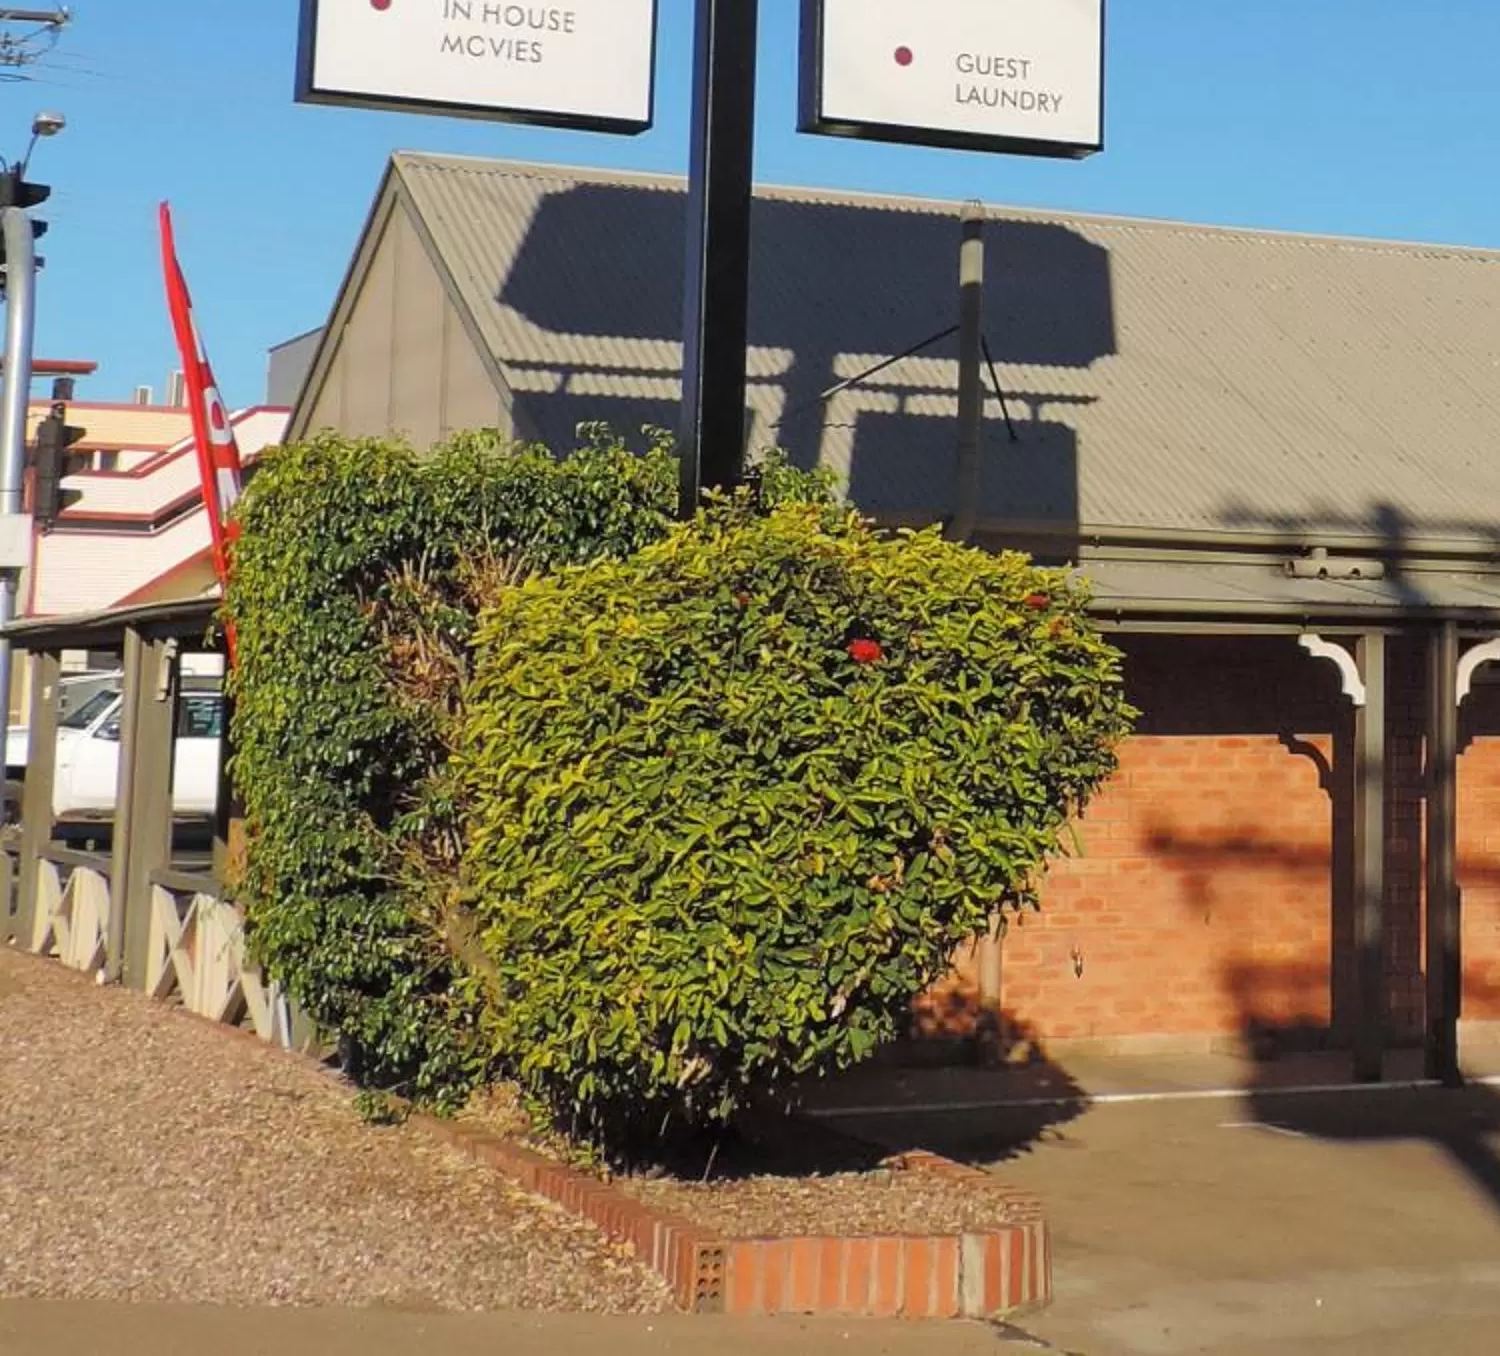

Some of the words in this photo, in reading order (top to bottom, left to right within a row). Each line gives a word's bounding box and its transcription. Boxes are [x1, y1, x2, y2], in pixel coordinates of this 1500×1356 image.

[482, 3, 576, 33] HOUSE
[956, 52, 1031, 79] GUEST
[955, 84, 1062, 113] LAUNDRY
